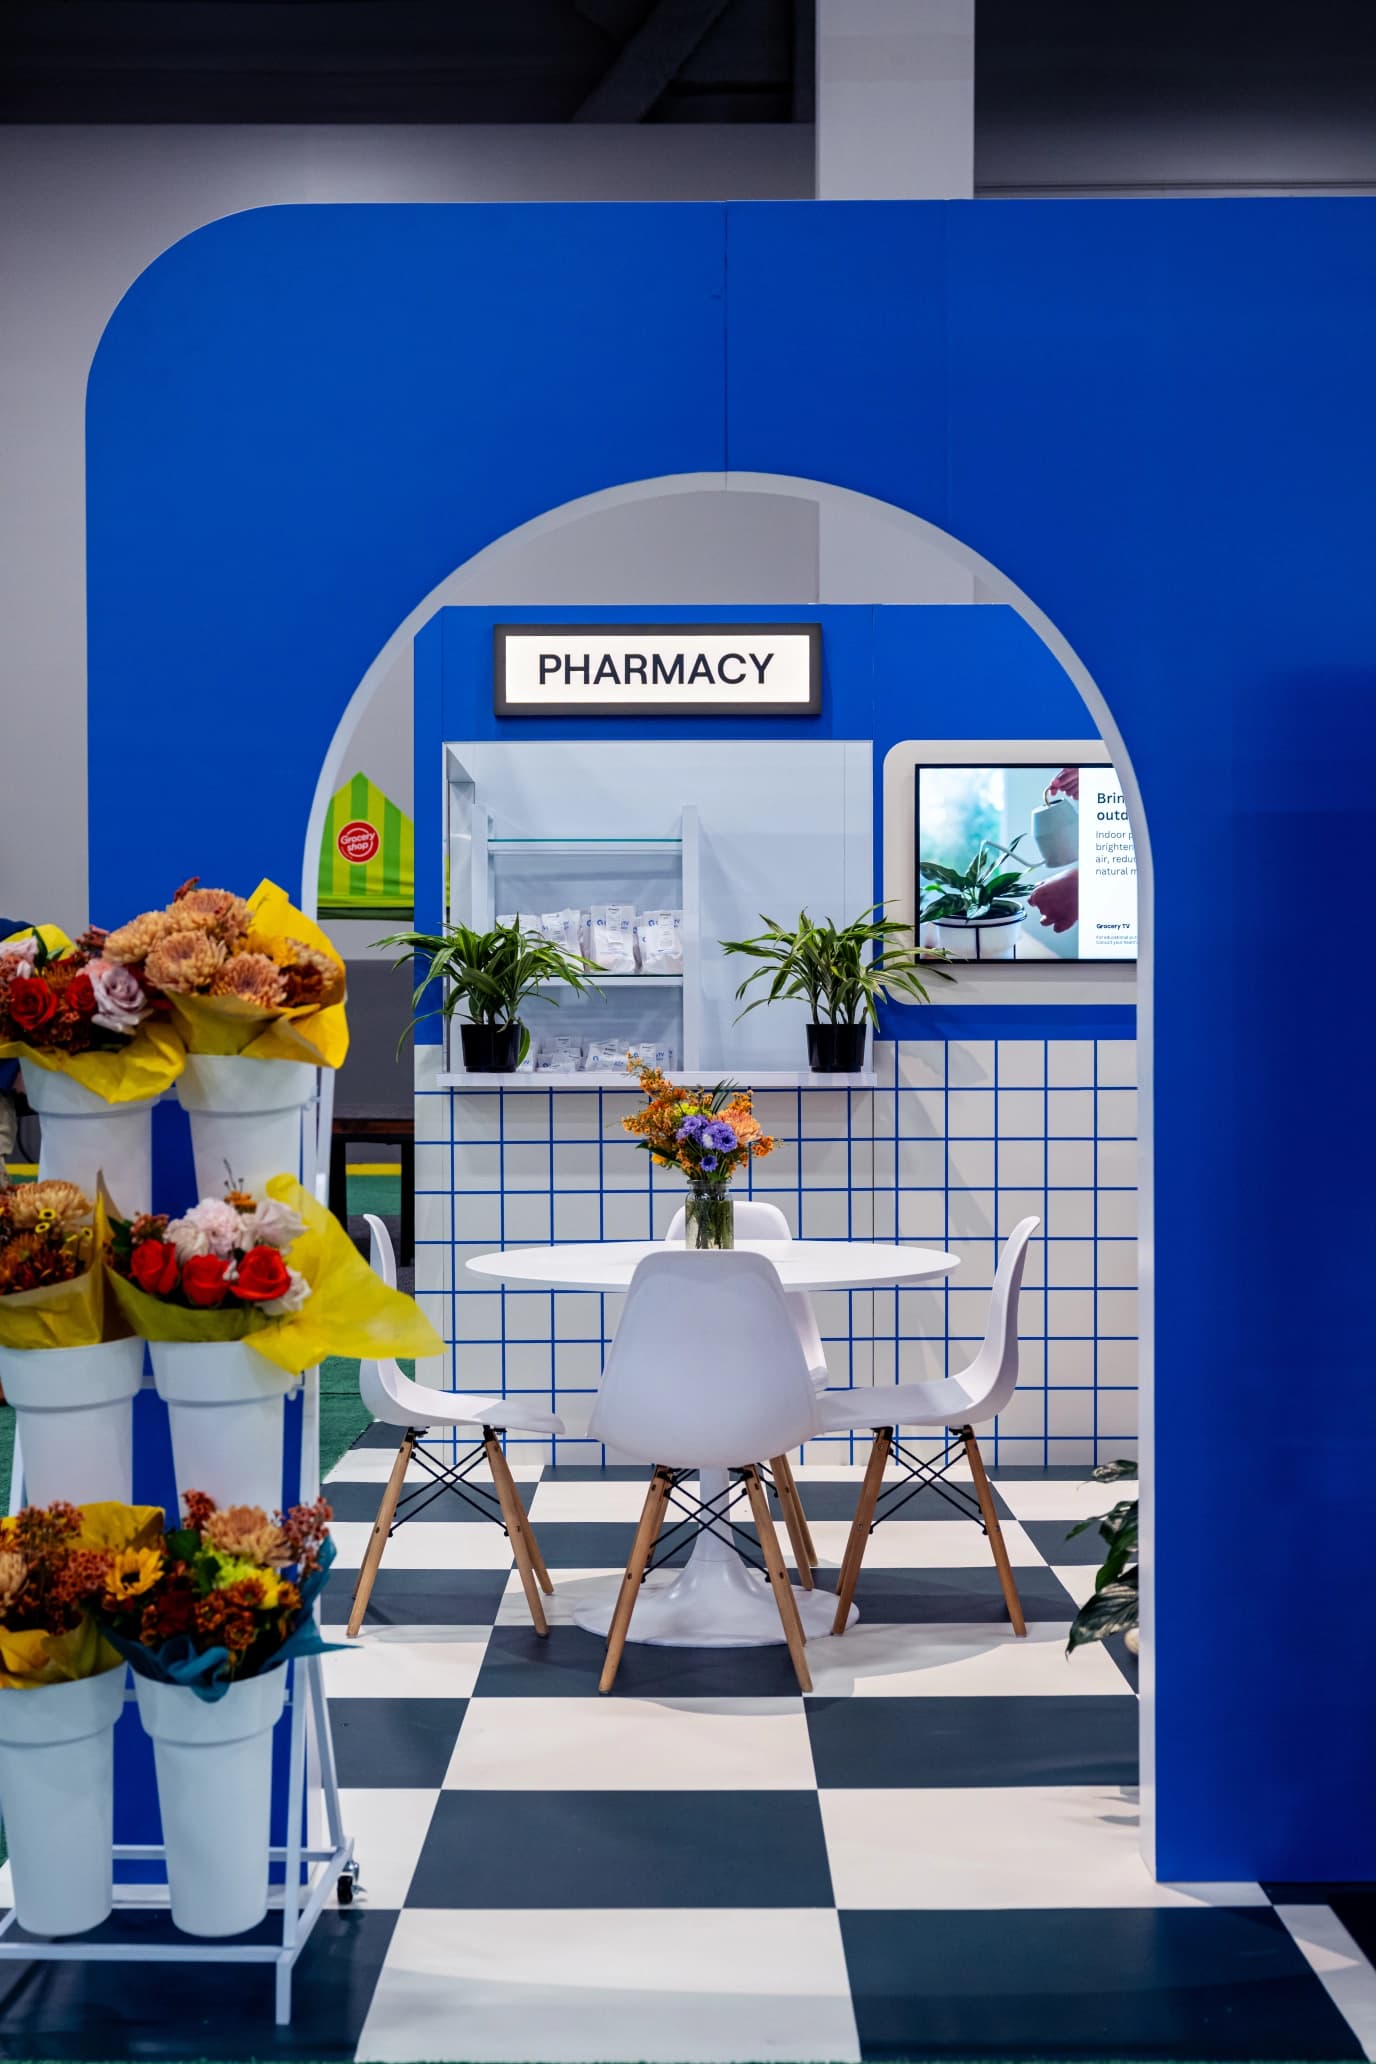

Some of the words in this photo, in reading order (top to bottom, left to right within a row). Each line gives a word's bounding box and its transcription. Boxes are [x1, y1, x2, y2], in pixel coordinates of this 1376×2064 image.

[538, 653, 775, 685] PHARMACY
[1096, 831, 1126, 839] Indoor
[1095, 867, 1129, 876] natural
[1096, 923, 1121, 931] Grocery
